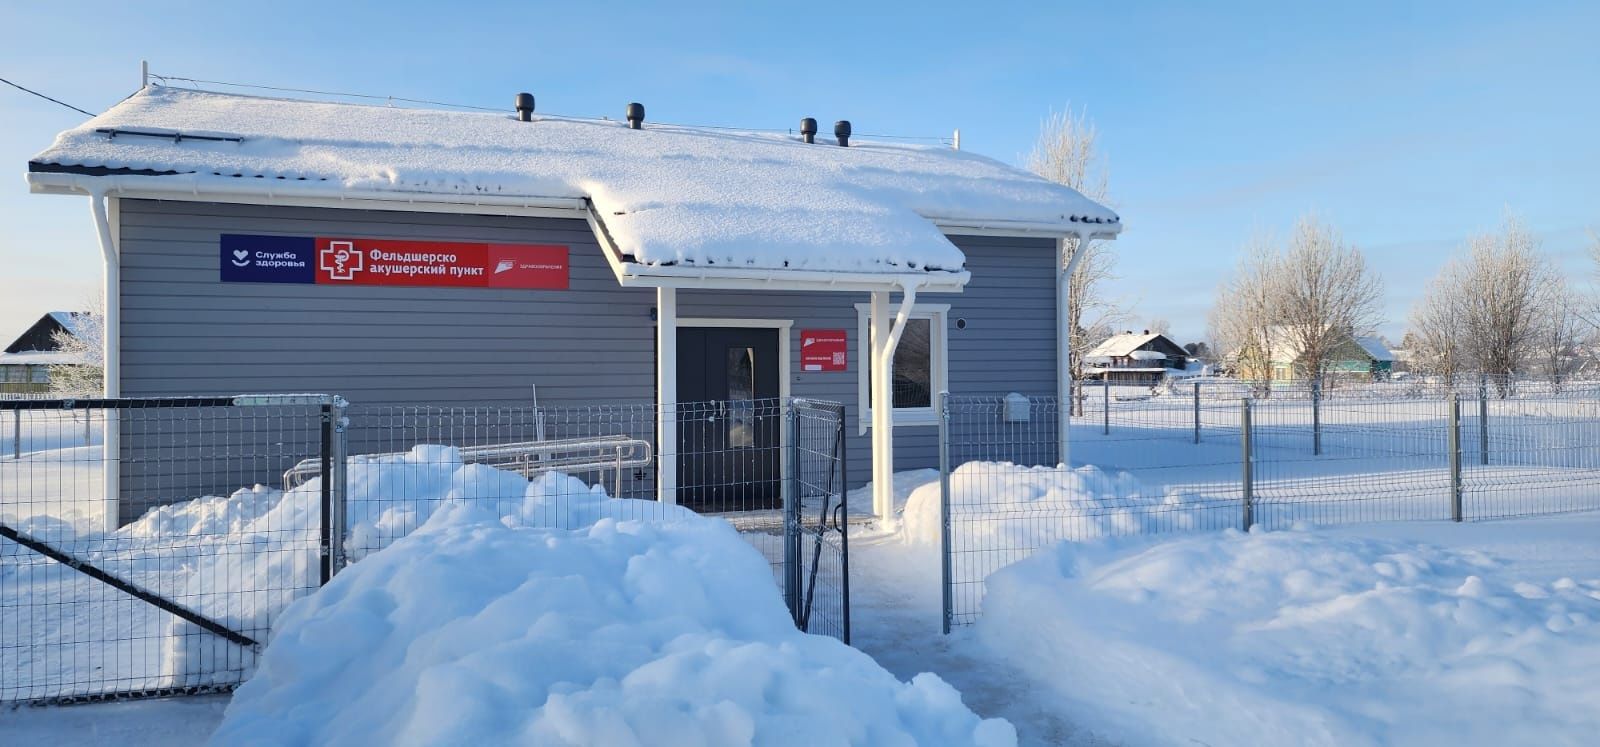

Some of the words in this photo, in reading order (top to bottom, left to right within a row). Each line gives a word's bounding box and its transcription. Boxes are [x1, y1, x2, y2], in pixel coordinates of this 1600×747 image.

[255, 251, 297, 261] Служба
[369, 249, 457, 265] Фельдшерско
[255, 260, 306, 268] здоровья
[369, 264, 446, 277] акушерский
[450, 266, 484, 278] пункт
